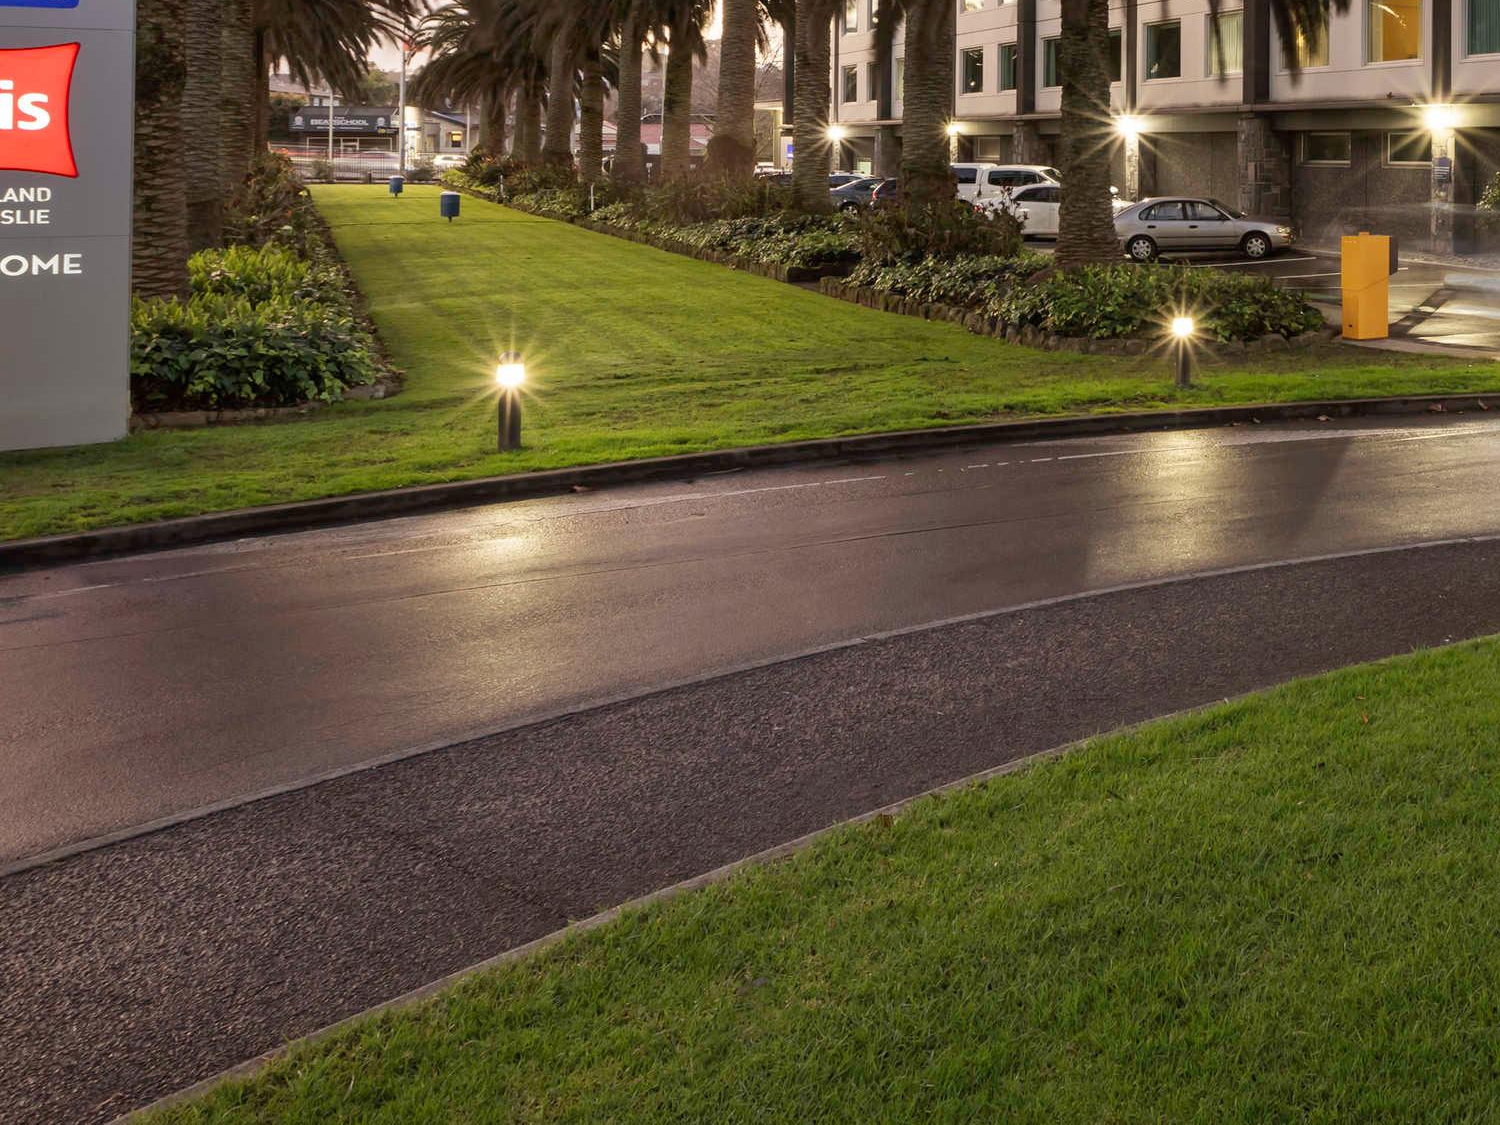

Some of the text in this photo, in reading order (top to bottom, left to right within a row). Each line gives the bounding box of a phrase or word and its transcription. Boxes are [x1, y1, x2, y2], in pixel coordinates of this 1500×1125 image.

[0, 79, 51, 130] is
[0, 187, 51, 202] AND
[0, 209, 50, 225] SLIE
[0, 253, 82, 276] OME
